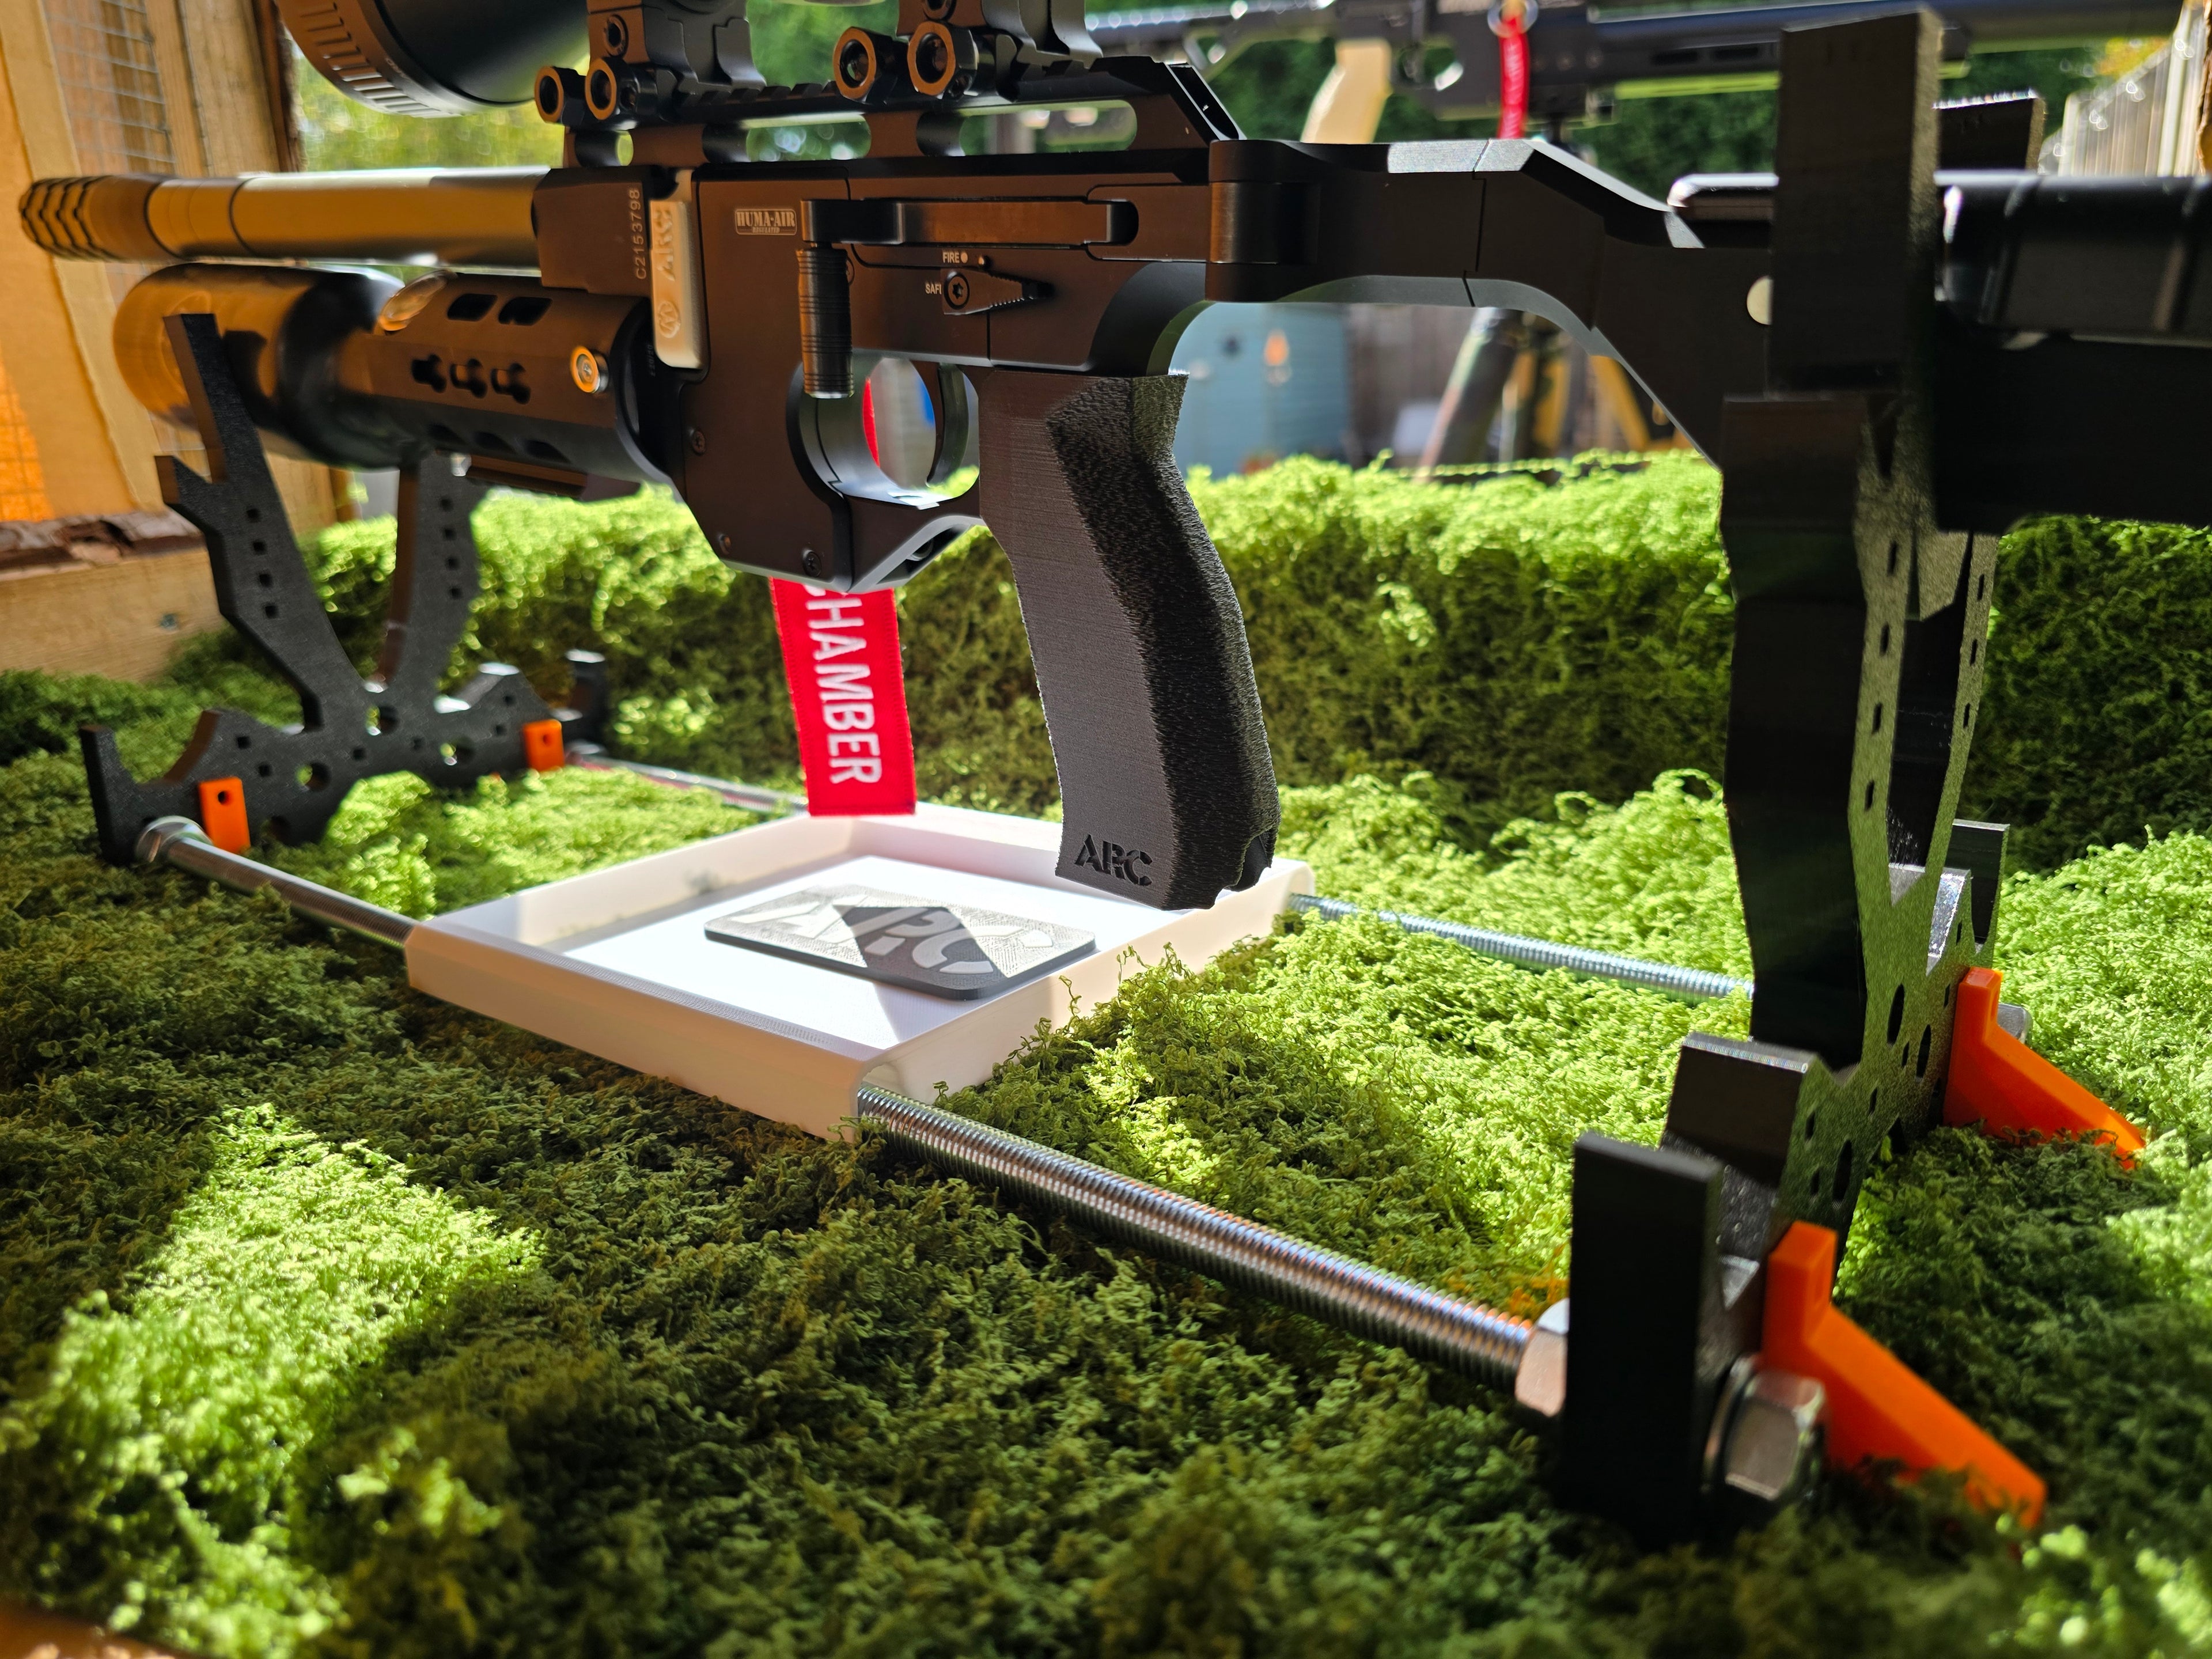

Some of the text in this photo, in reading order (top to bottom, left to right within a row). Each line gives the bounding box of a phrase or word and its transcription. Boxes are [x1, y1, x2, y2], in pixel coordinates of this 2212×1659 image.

[628, 188, 646, 279] C2153798
[942, 251, 960, 263] FIRE
[804, 585, 882, 784] HAMBER
[1074, 834, 1153, 887] ARC
[730, 894, 1053, 975] ARC
